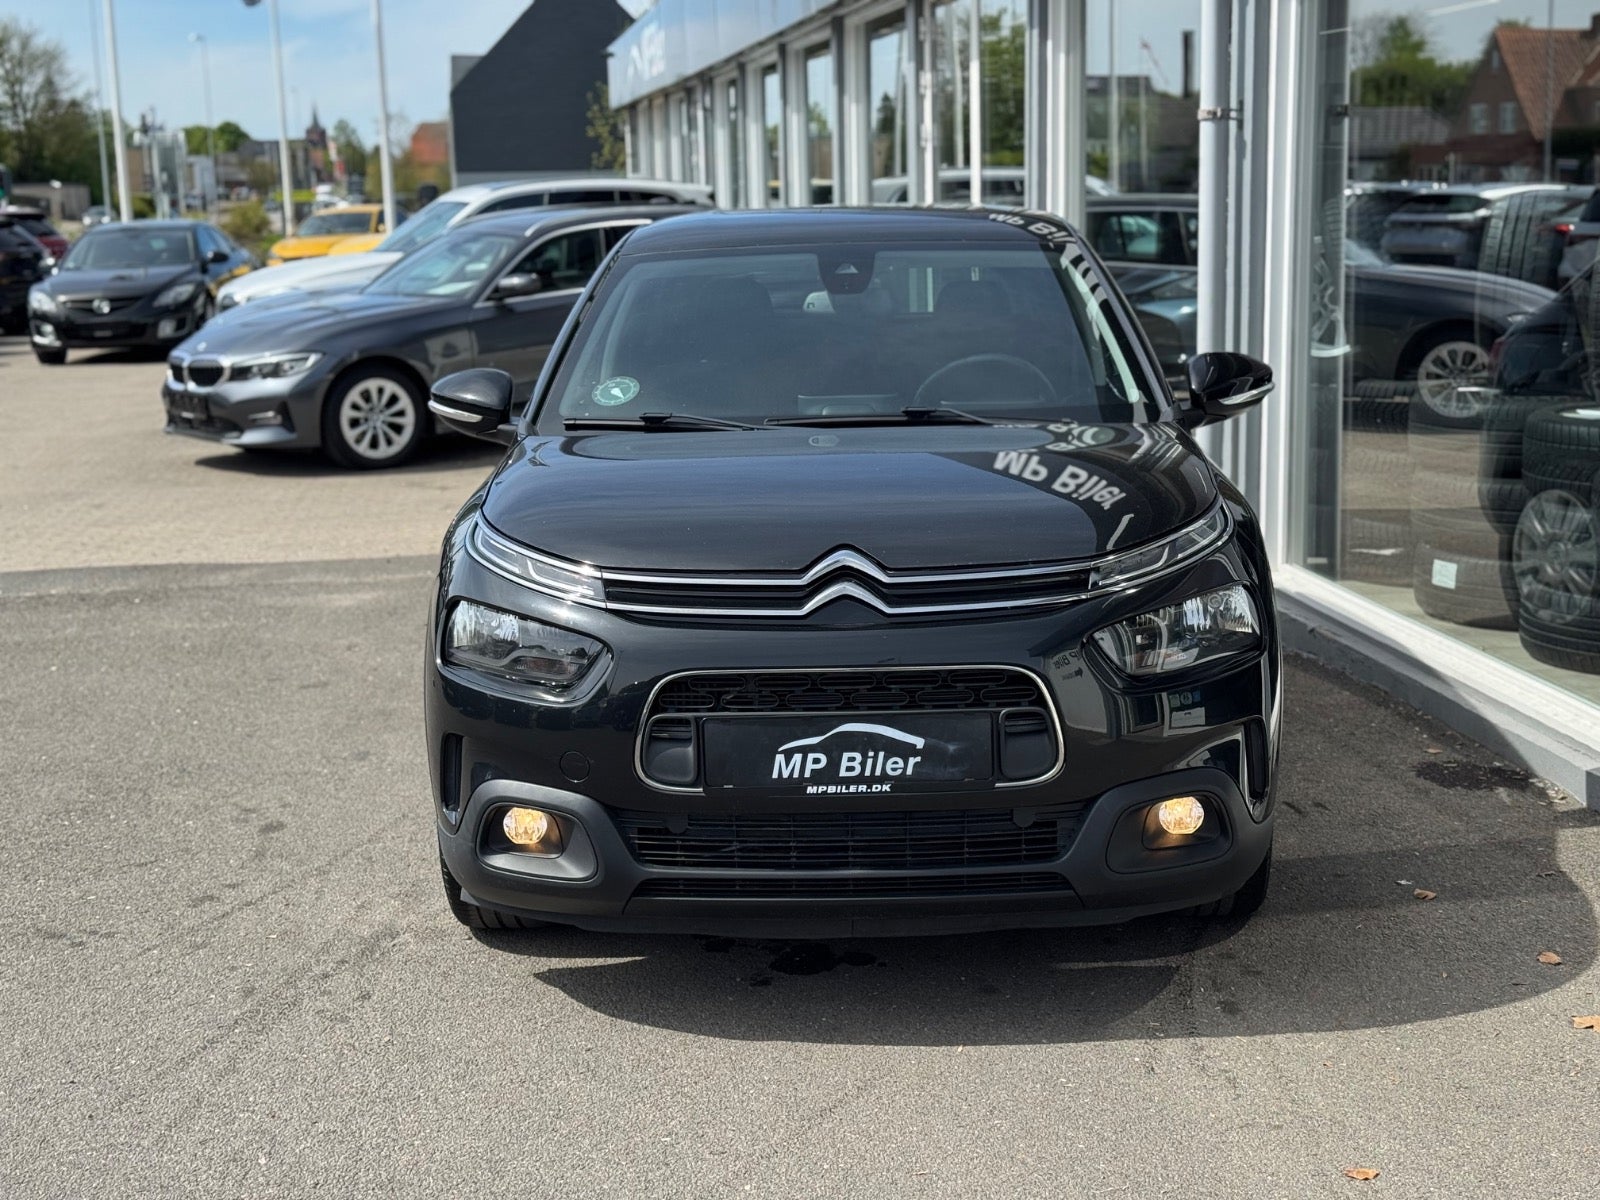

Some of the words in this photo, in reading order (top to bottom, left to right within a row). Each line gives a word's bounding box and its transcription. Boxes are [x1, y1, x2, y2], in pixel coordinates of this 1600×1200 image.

[772, 753, 827, 779] MP
[839, 751, 922, 777] Biler
[806, 783, 892, 794] MPBILER.DK
